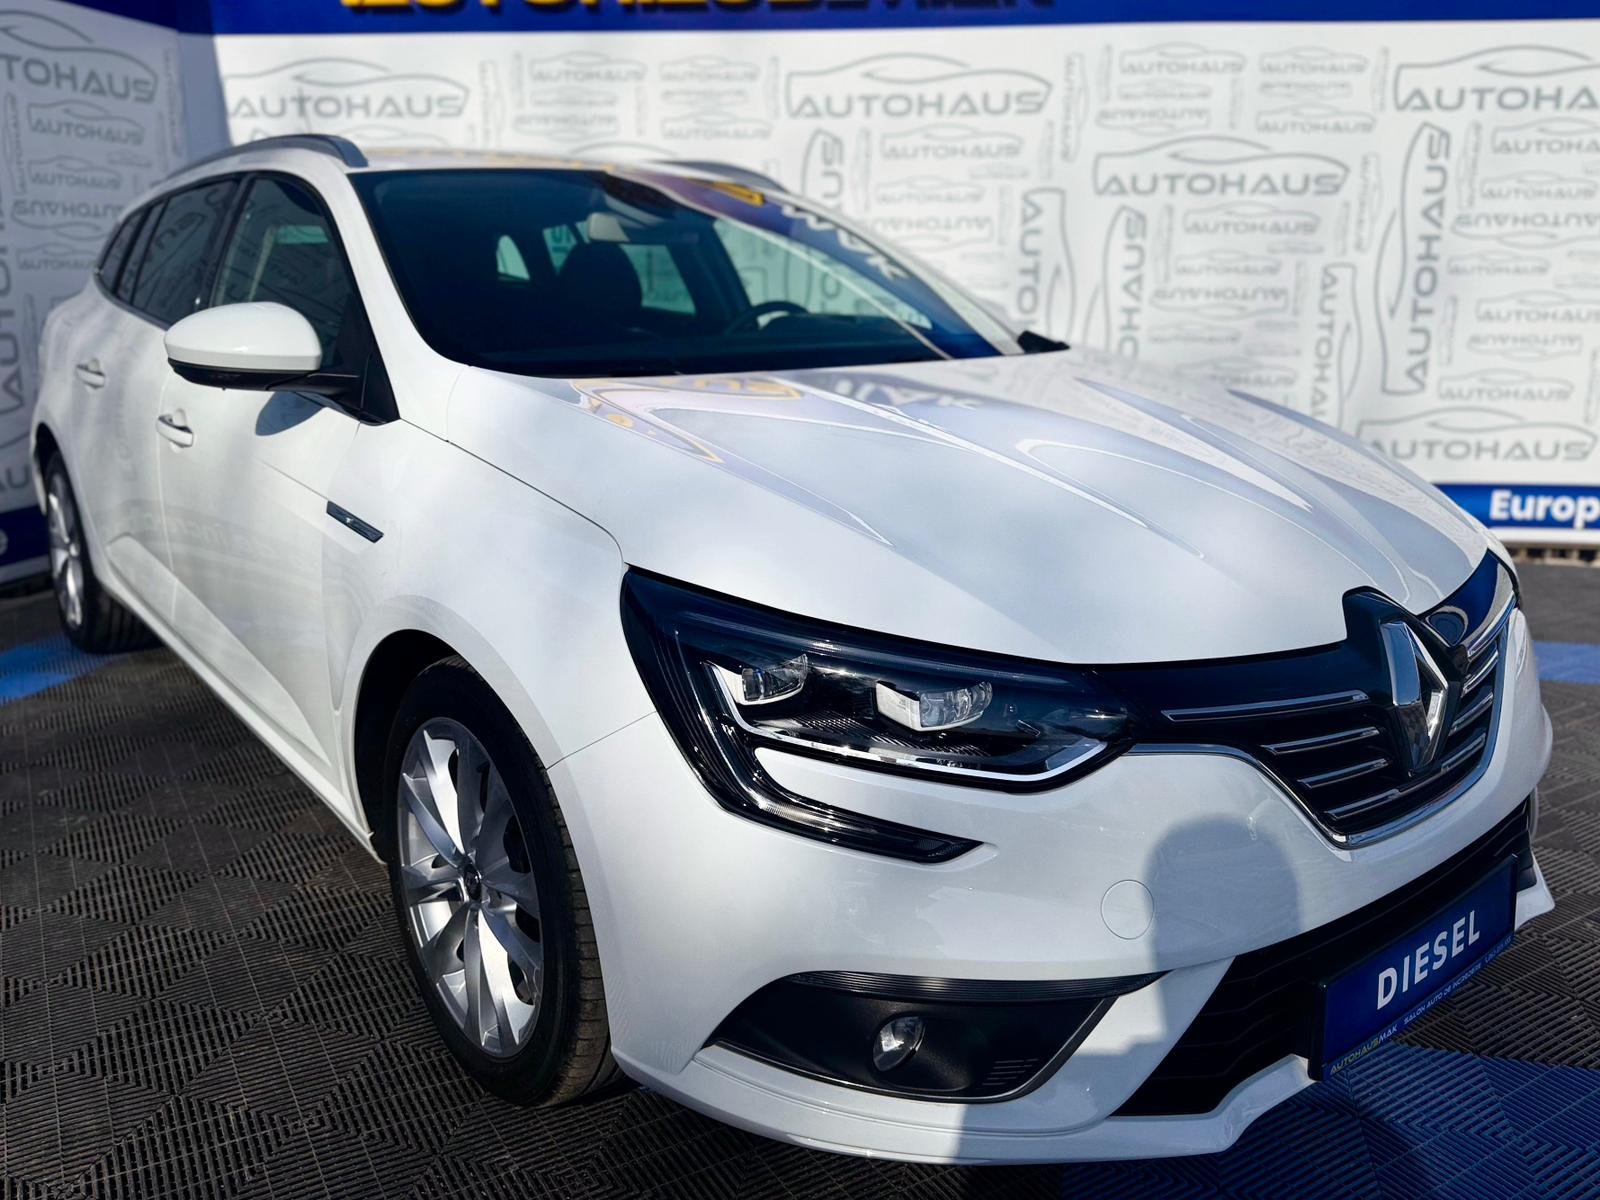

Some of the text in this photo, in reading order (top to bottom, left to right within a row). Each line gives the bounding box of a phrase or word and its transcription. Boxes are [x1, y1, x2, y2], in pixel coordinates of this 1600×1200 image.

[232, 95, 464, 118] AUTOHAUS
[792, 91, 1043, 118] AUTOHAUS
[1397, 86, 1600, 112] AUTOHA
[32, 117, 144, 147] AUTOHAUS
[881, 144, 1022, 160] AUTOHAUS
[1099, 173, 1343, 196] AUTOHAUS
[1183, 220, 1321, 234] AUTOHAUS
[1017, 202, 1042, 324] AUTO
[1406, 131, 1450, 388] AUTOHAUS
[1310, 268, 1338, 416] AUTOHA
[1440, 387, 1573, 401] AUTOHAUS
[1489, 490, 1600, 529] Europ
[1377, 910, 1480, 1010] DIESEL
